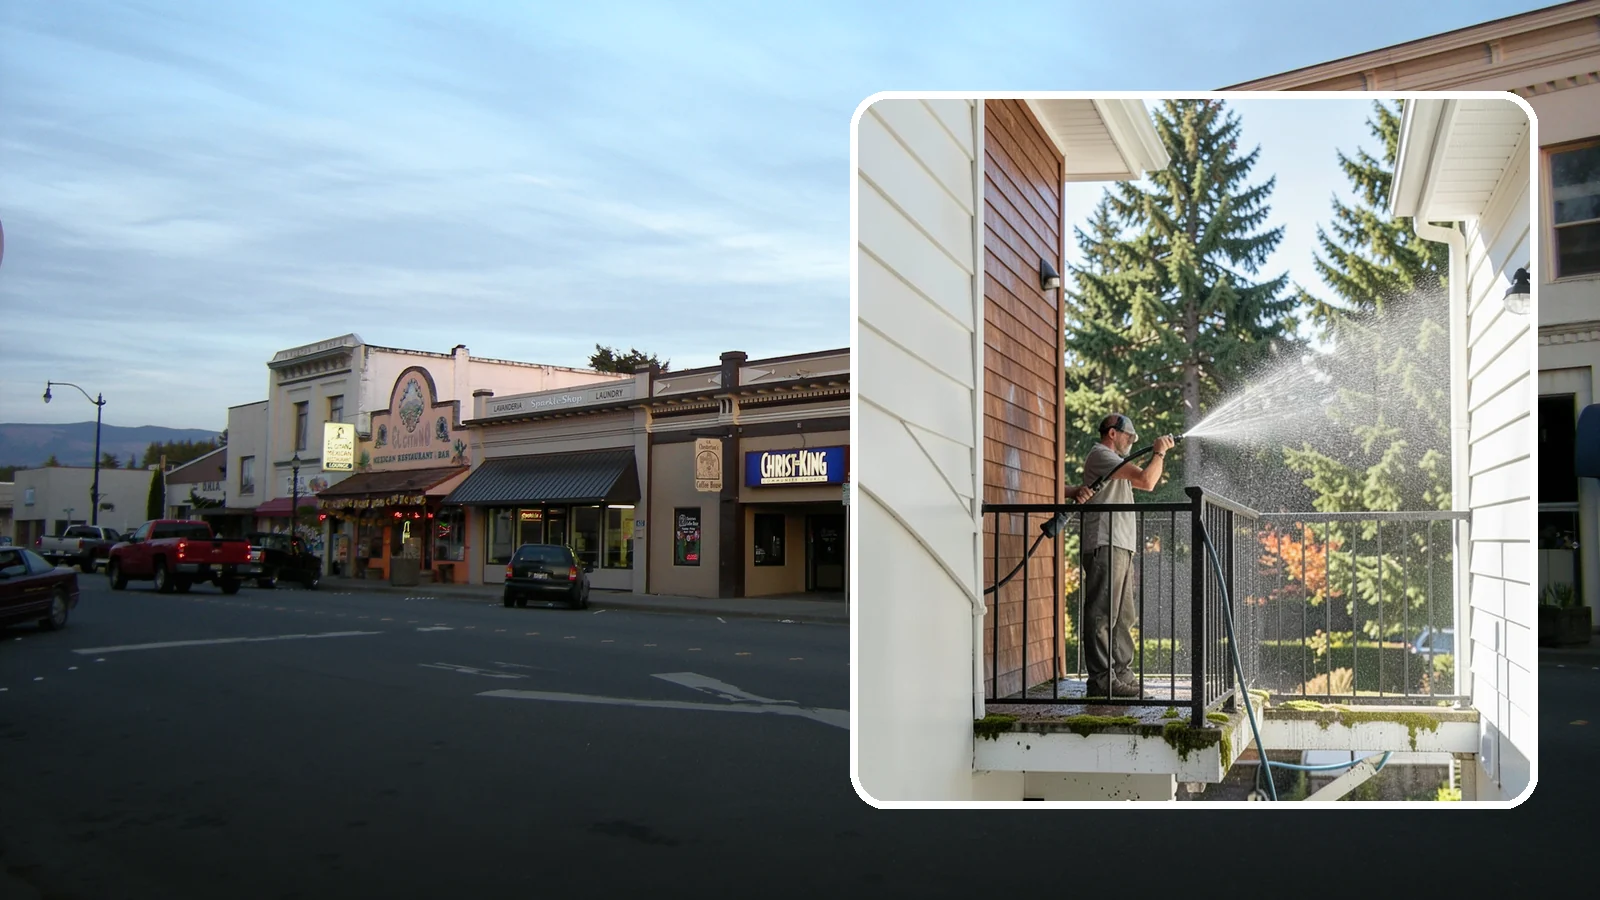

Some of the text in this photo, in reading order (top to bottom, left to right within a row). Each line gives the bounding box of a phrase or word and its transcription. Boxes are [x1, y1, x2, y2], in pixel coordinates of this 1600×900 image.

[561, 394, 582, 405] Shop
[595, 389, 624, 400] LAUNDRY
[493, 402, 523, 413] LAVANDERIA
[373, 450, 450, 464] MEXICAN RESTAURANT BAR
[761, 450, 827, 478] CHRIST KING
[697, 480, 709, 489] Coffee
